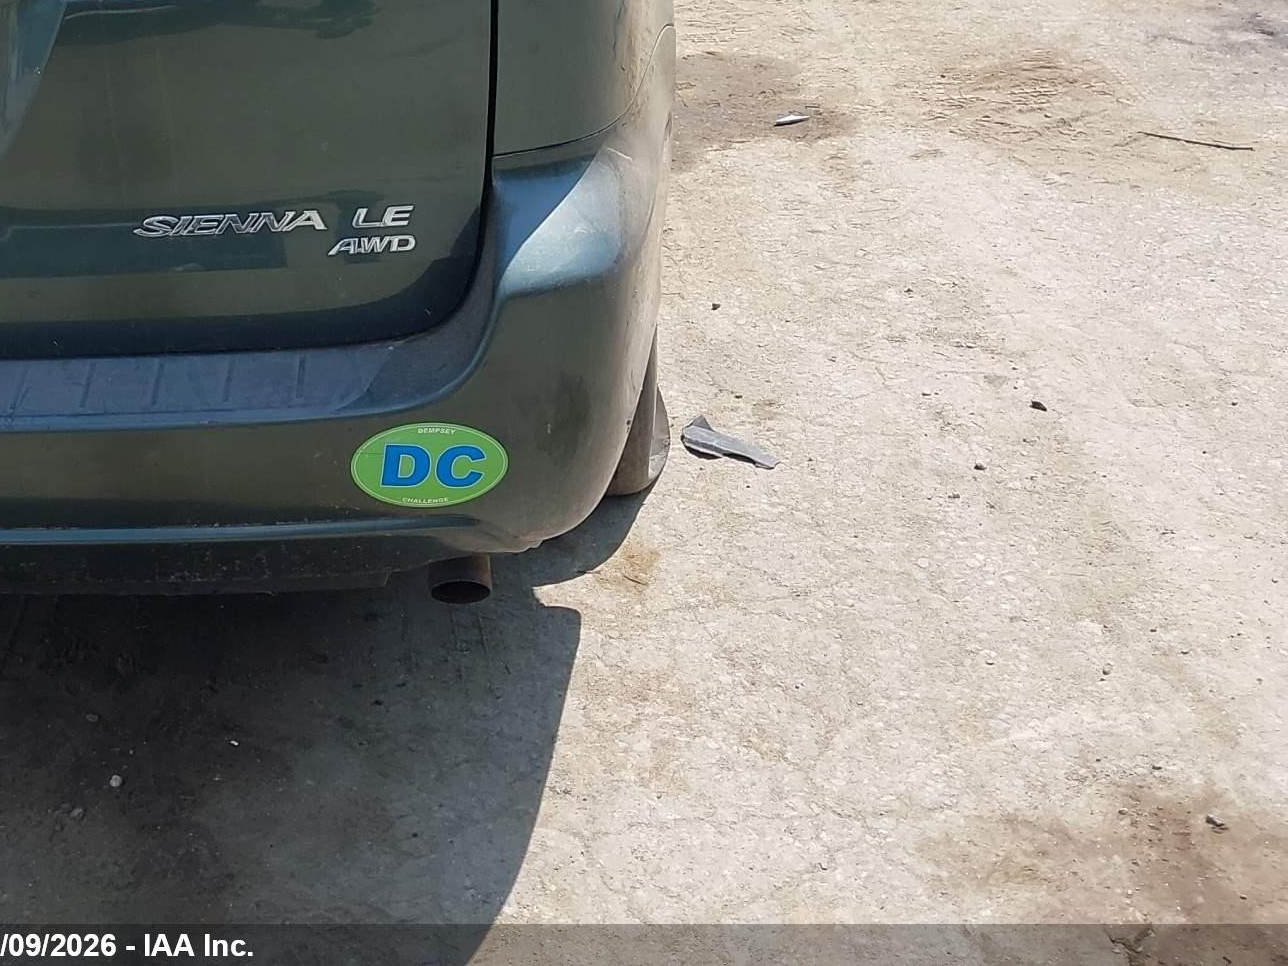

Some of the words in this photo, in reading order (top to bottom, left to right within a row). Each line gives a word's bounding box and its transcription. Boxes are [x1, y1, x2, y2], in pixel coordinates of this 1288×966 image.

[133, 209, 328, 237] SIENNA
[351, 205, 414, 228] LE
[327, 235, 416, 256] AWD
[417, 427, 456, 435] DEMPSEY
[380, 443, 487, 488] DC
